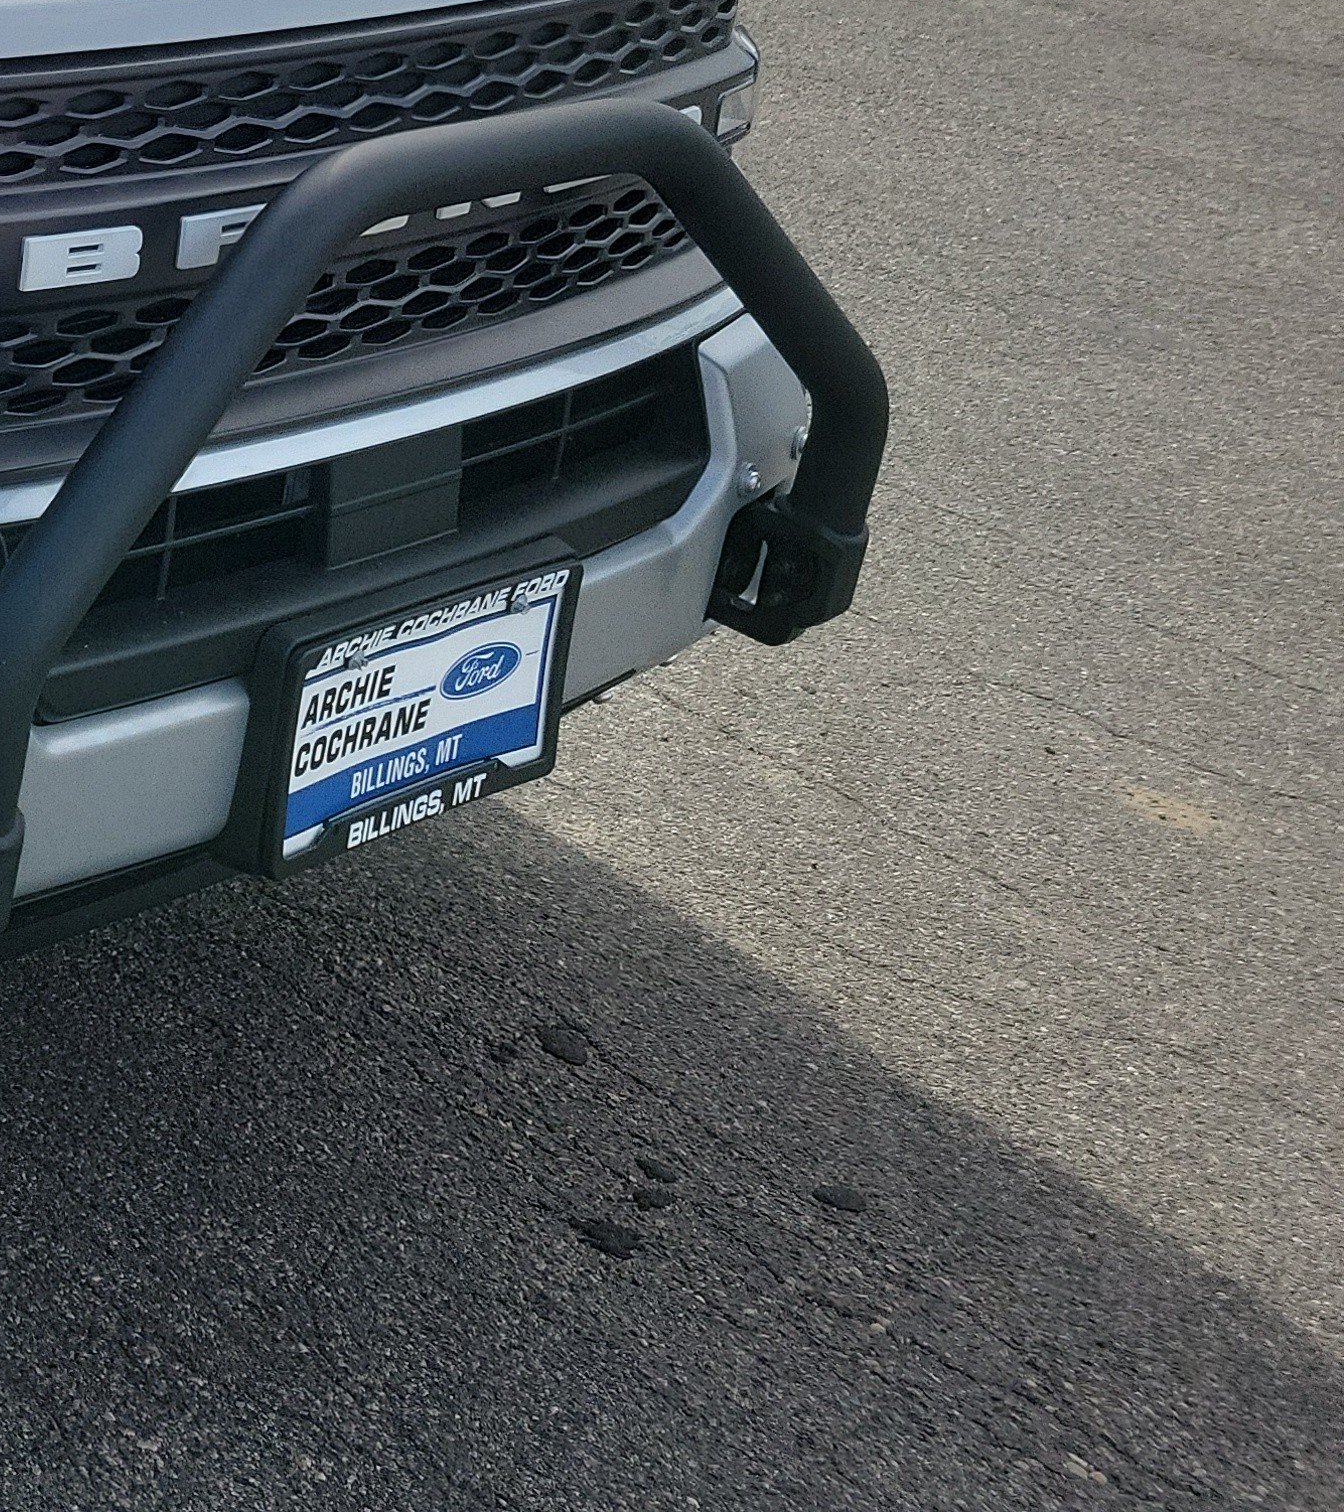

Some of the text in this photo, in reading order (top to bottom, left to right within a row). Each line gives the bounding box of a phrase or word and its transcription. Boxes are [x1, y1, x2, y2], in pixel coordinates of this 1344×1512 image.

[316, 569, 570, 670] ARCHIE COCHRANE FORD
[302, 665, 396, 730] ARCHIE
[454, 649, 504, 692] Ford
[295, 699, 431, 777] COCHRANE
[350, 734, 463, 800] BILLINGS, MT
[346, 773, 487, 850] BILLINGS, MT
